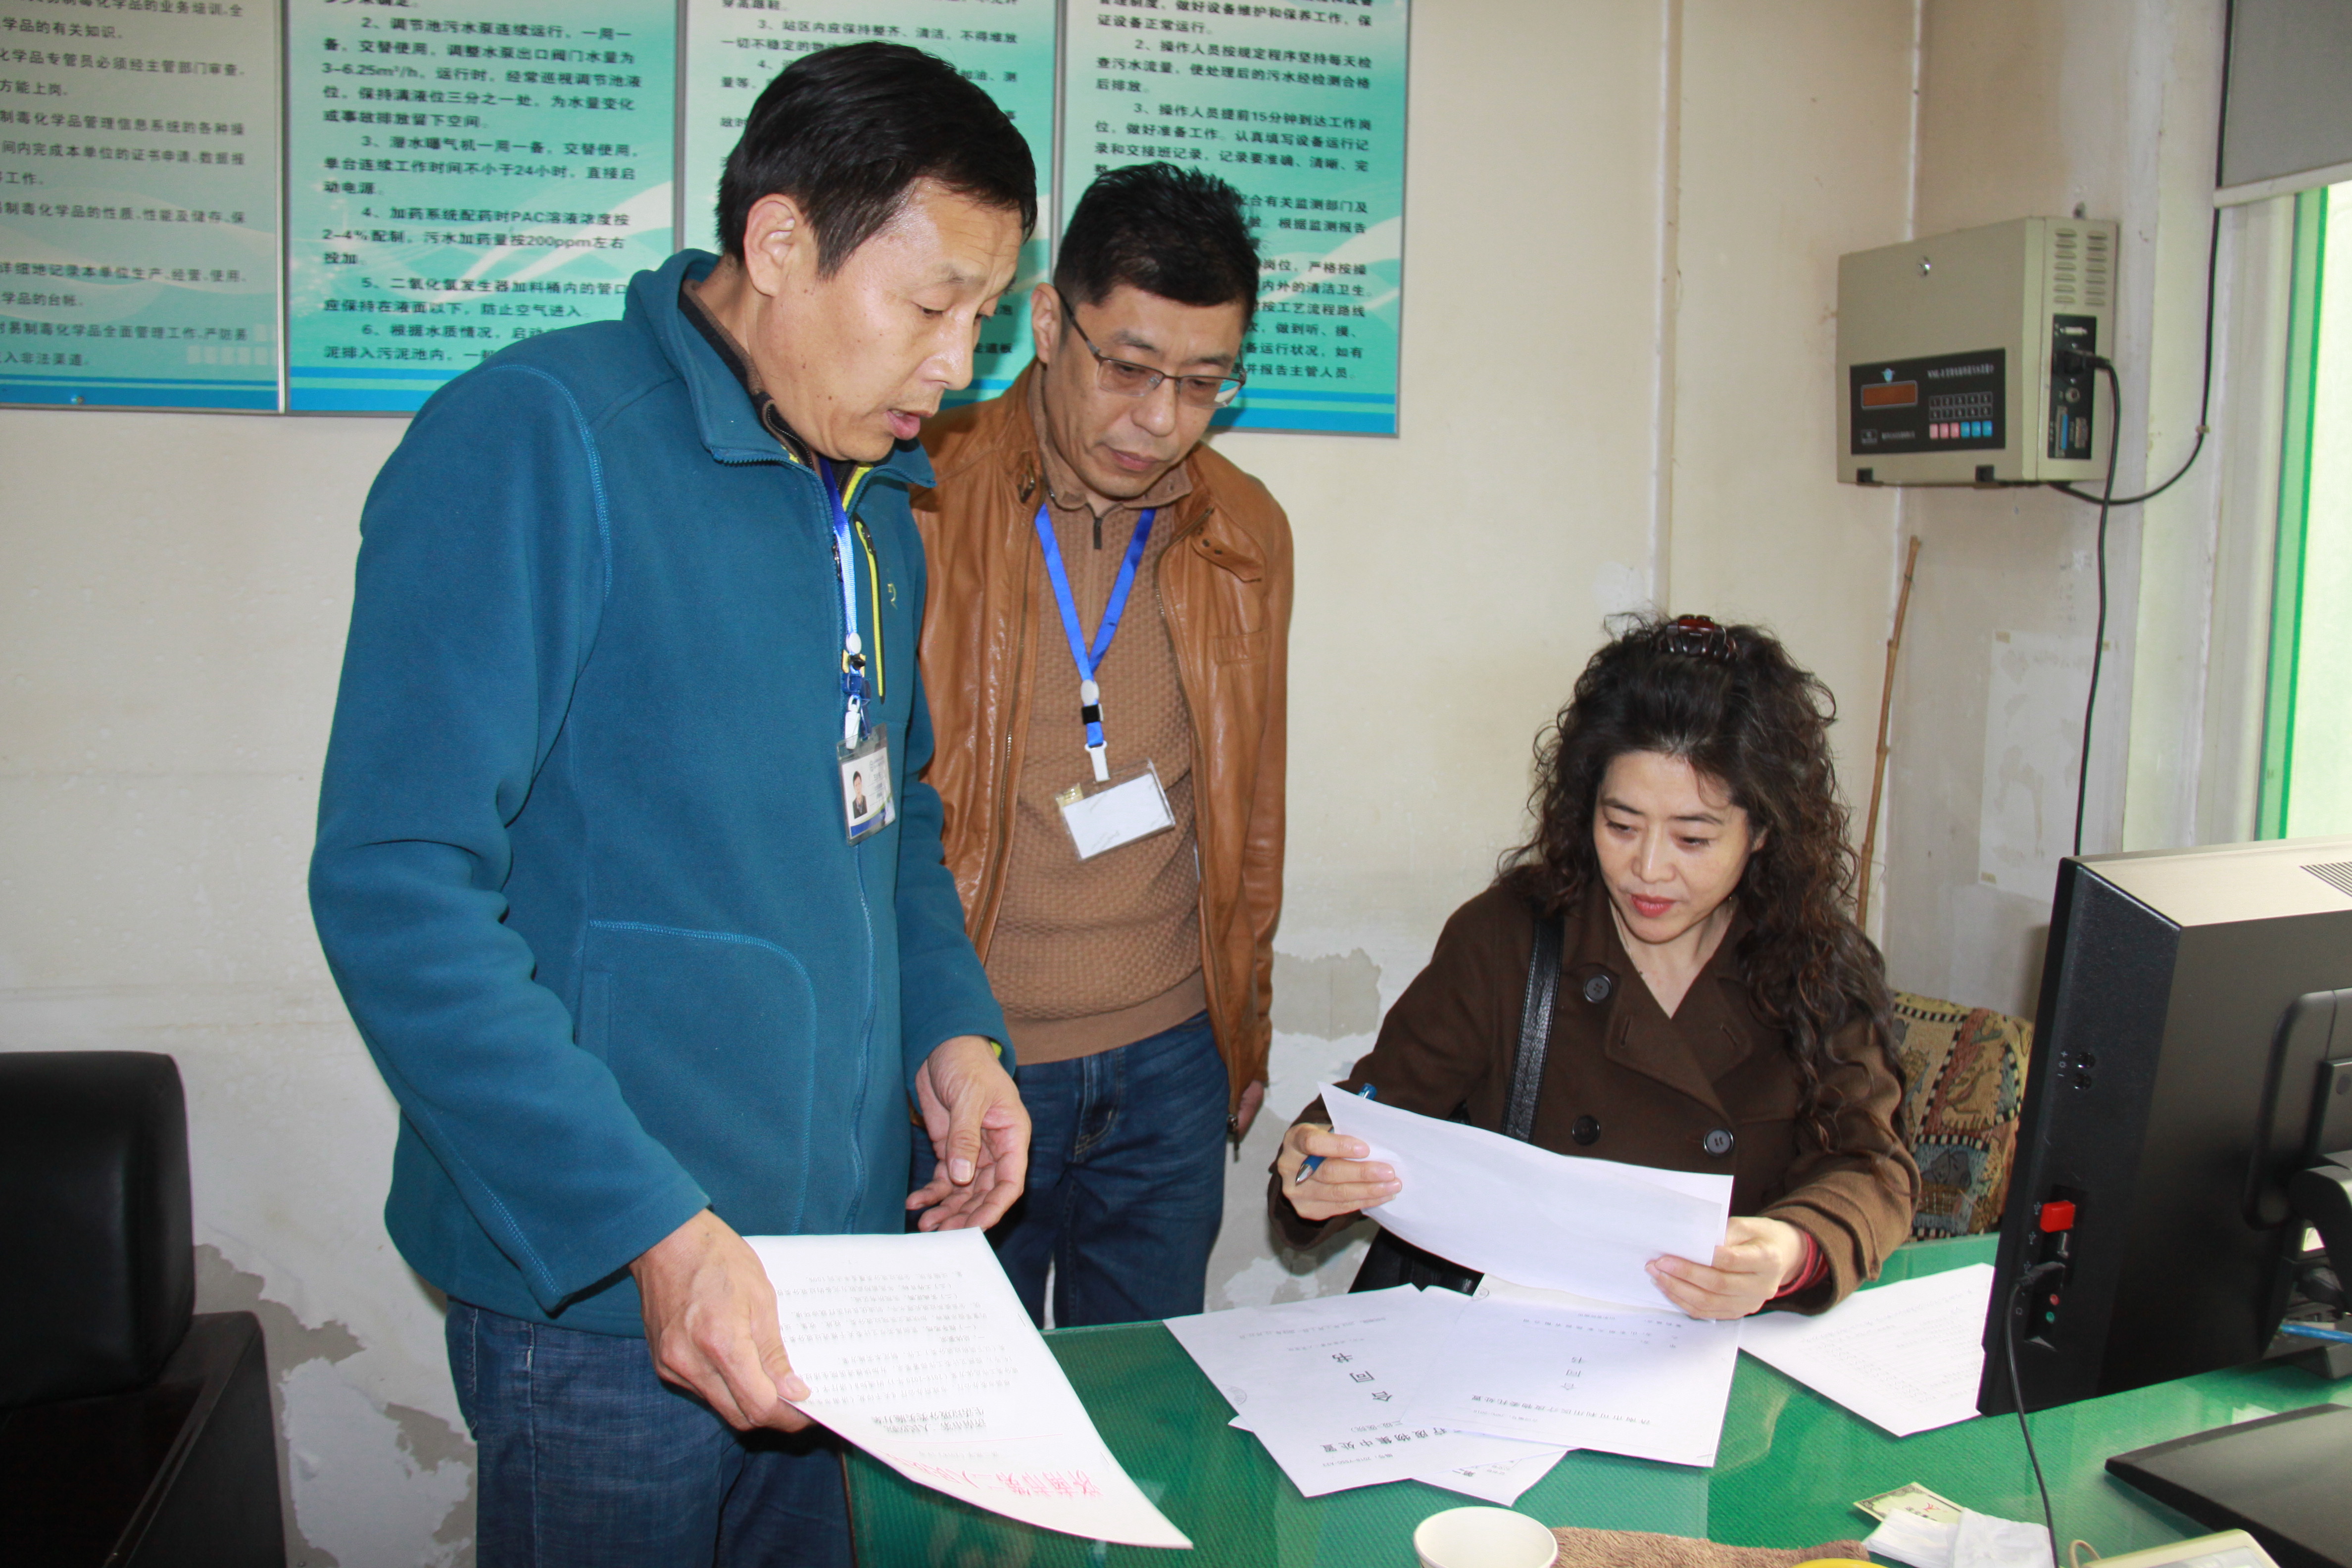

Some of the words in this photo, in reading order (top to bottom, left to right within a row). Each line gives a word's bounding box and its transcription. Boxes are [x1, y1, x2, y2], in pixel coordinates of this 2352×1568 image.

[0, 171, 44, 186] 工作。
[0, 351, 90, 366] 入非法渠道。
[1320, 1427, 1462, 1453] 疗废物集中处置
